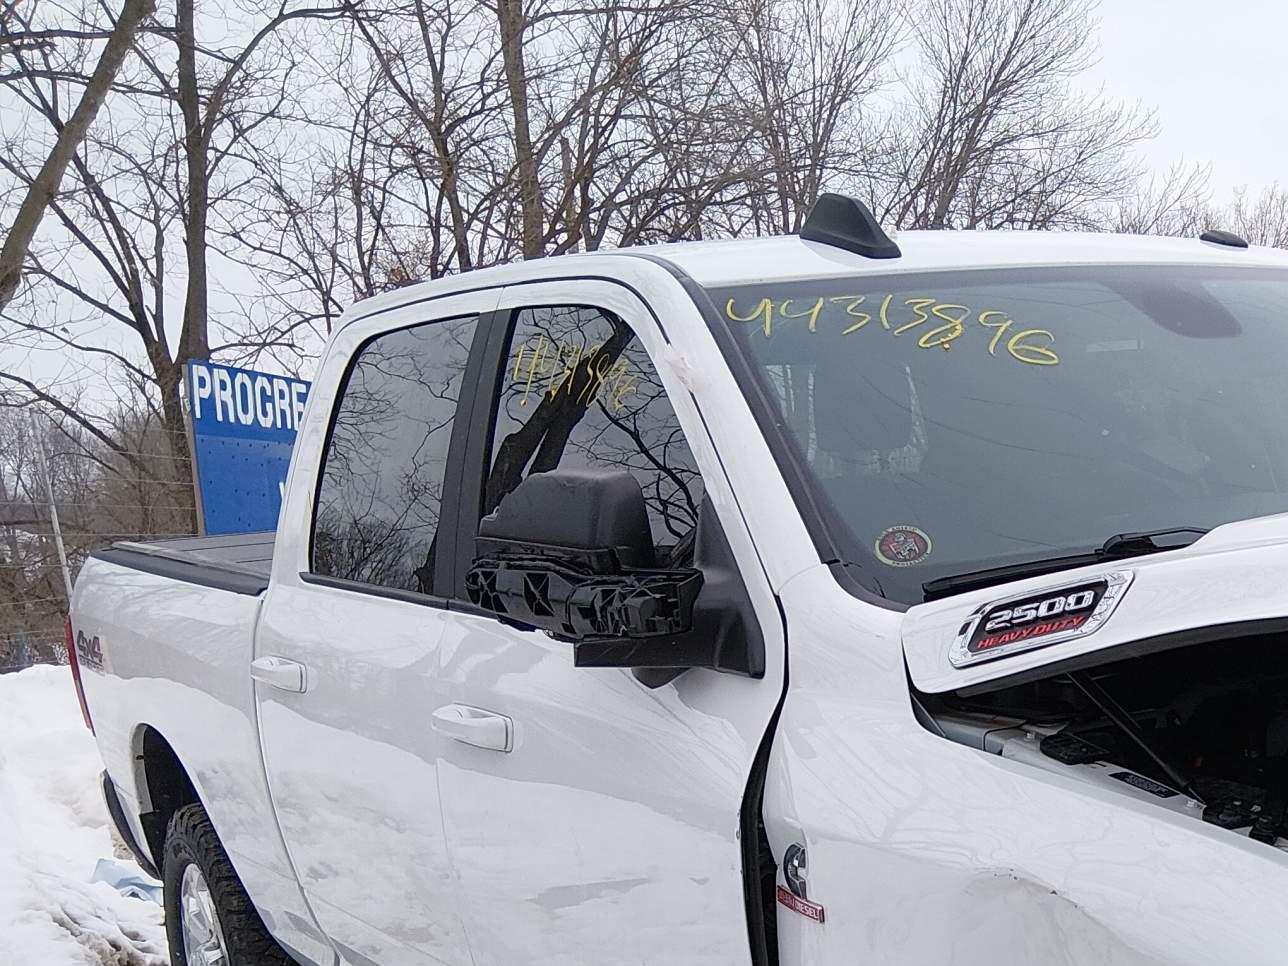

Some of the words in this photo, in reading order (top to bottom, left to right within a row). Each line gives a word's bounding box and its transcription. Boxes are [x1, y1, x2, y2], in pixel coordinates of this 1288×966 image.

[725, 294, 1059, 365] 44313896
[192, 364, 307, 431] PROGRE
[977, 629, 1033, 649] HEAVY
[1031, 616, 1085, 635] DUTY
[985, 590, 1095, 631] 2500
